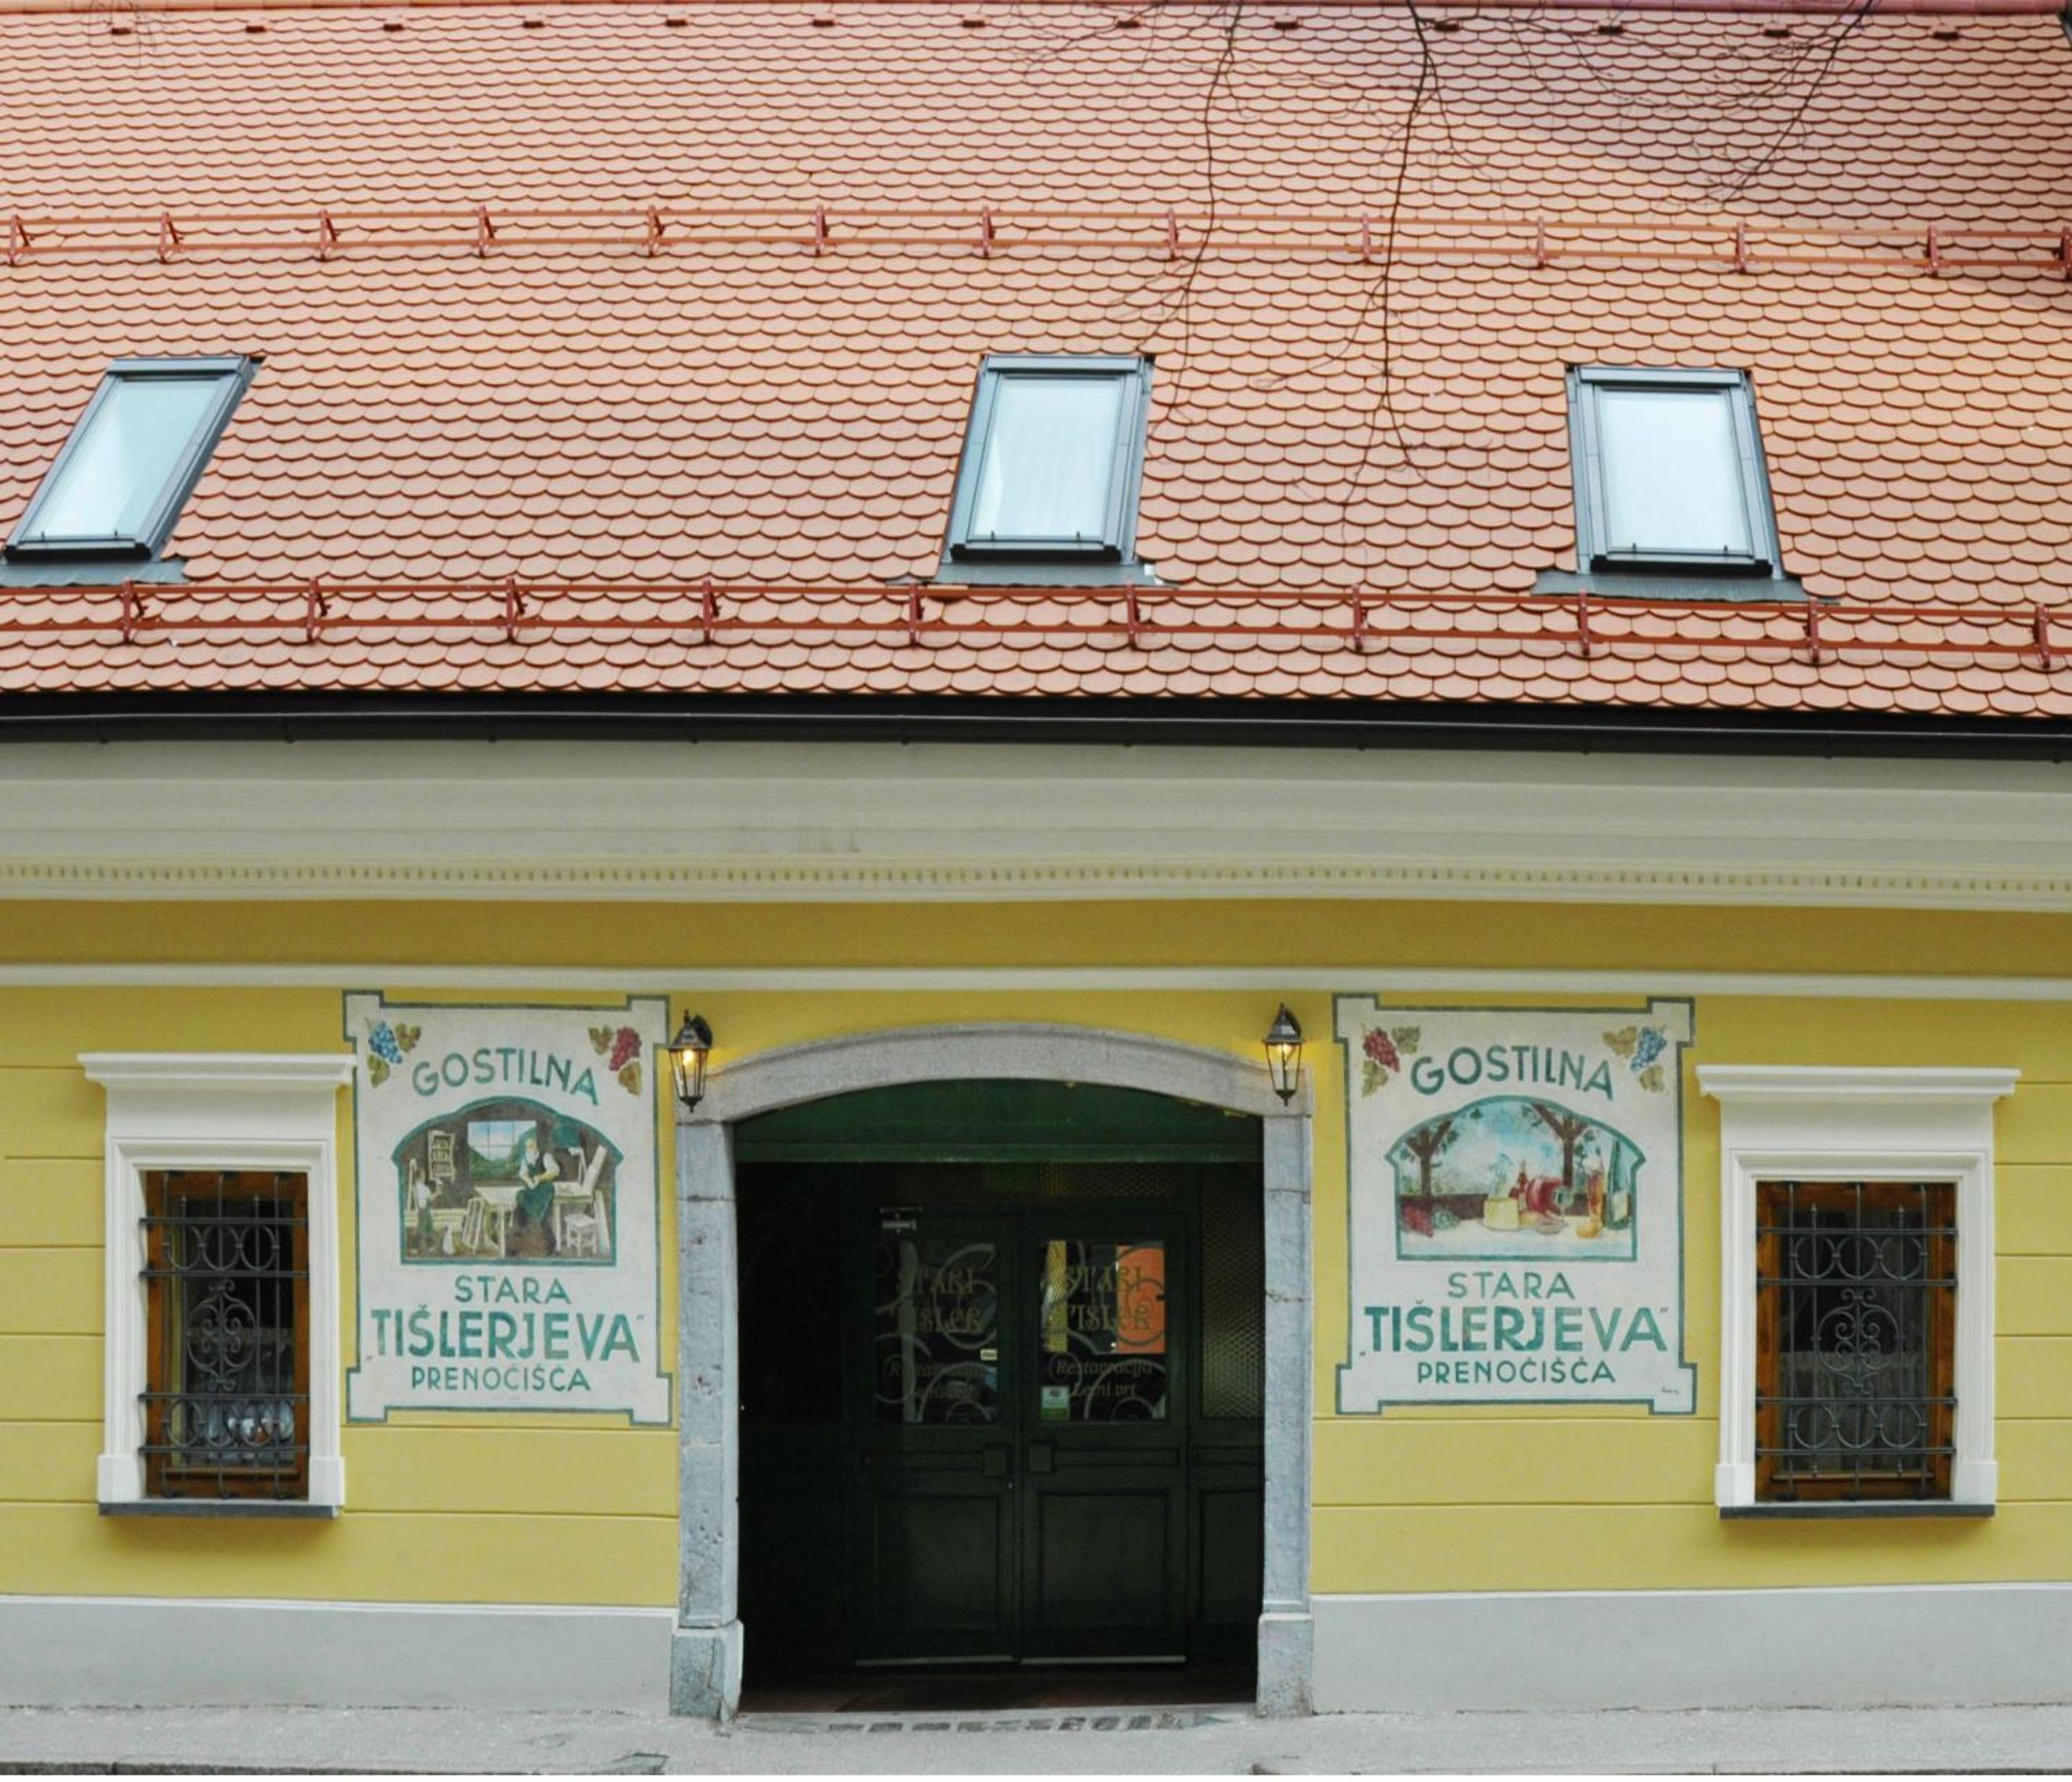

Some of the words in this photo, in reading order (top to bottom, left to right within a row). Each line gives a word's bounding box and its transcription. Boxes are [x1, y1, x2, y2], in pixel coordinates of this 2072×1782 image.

[412, 1047, 599, 1106] GOSTILNA
[1410, 1044, 1614, 1101] GOSTILNA
[455, 1275, 571, 1304] STARA
[895, 1266, 974, 1294] TARI
[1448, 1272, 1575, 1300] STARA
[411, 1366, 591, 1392] PRENOČIŠČA
[1418, 1356, 1616, 1384] PRENOČIŠČA
